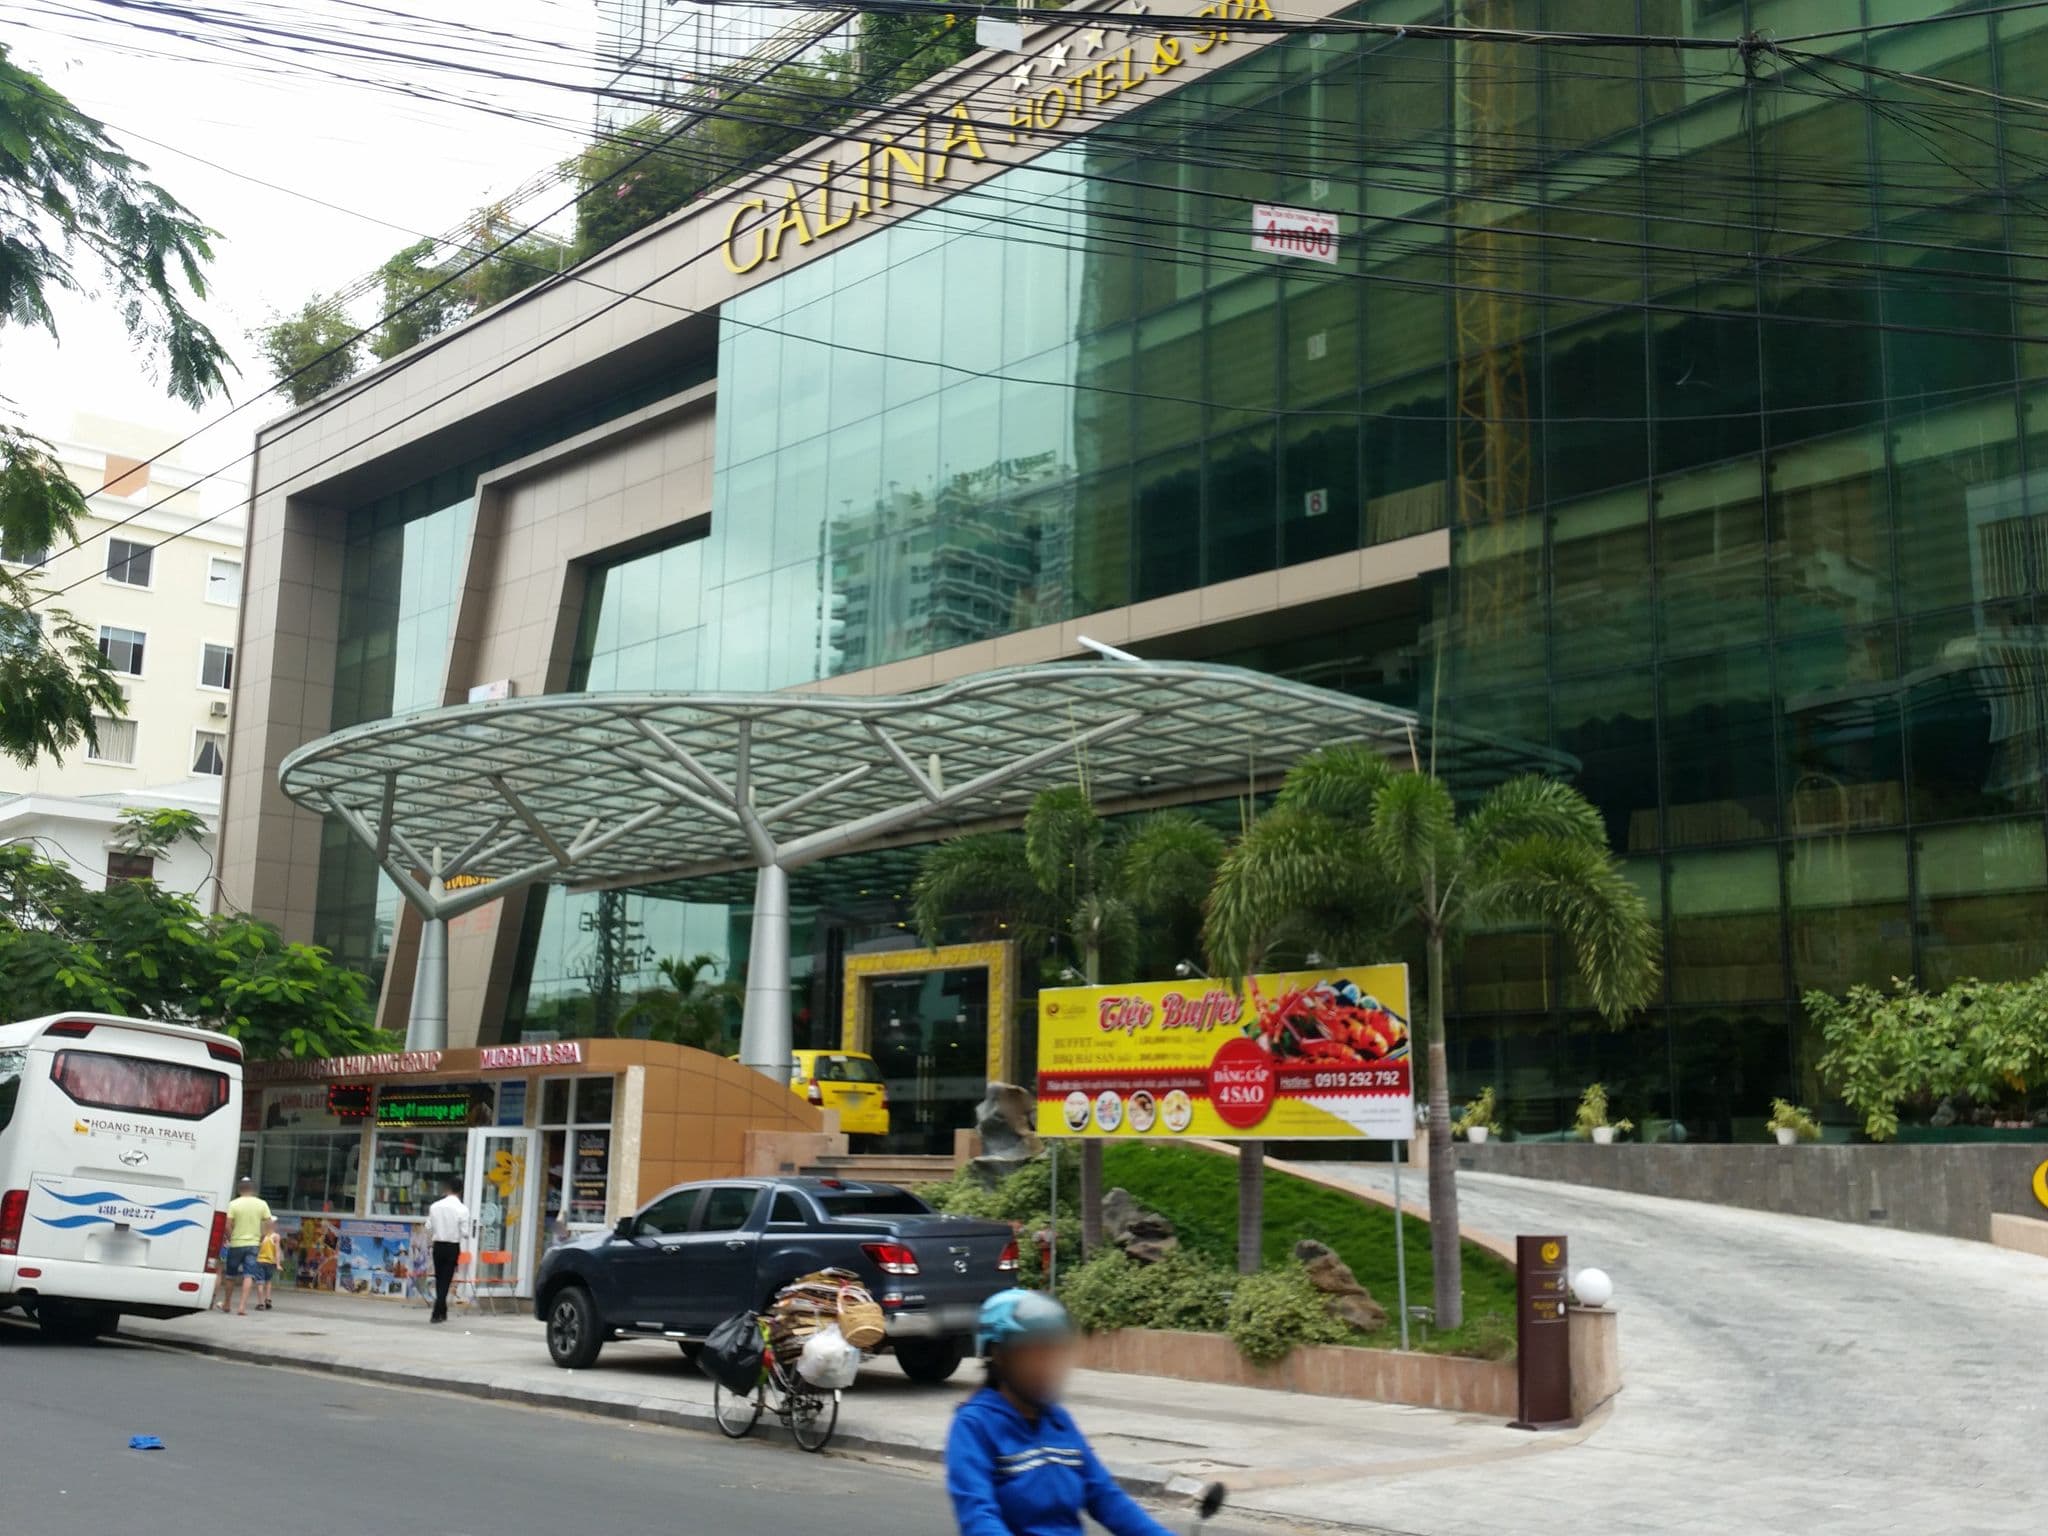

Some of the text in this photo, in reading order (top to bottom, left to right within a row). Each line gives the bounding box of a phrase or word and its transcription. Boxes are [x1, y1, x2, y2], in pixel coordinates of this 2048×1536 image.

[722, 0, 1275, 275] GALINA HOTEL & SPA
[1161, 989, 1245, 1032] Buffet
[554, 1042, 582, 1064] SPA
[1314, 1073, 1347, 1088] 0919
[1348, 1072, 1373, 1086] 292
[1375, 1070, 1400, 1085] 792
[1219, 1085, 1265, 1103] 4 SAO
[90, 1119, 197, 1142] HOANG TRA TRAVEL
